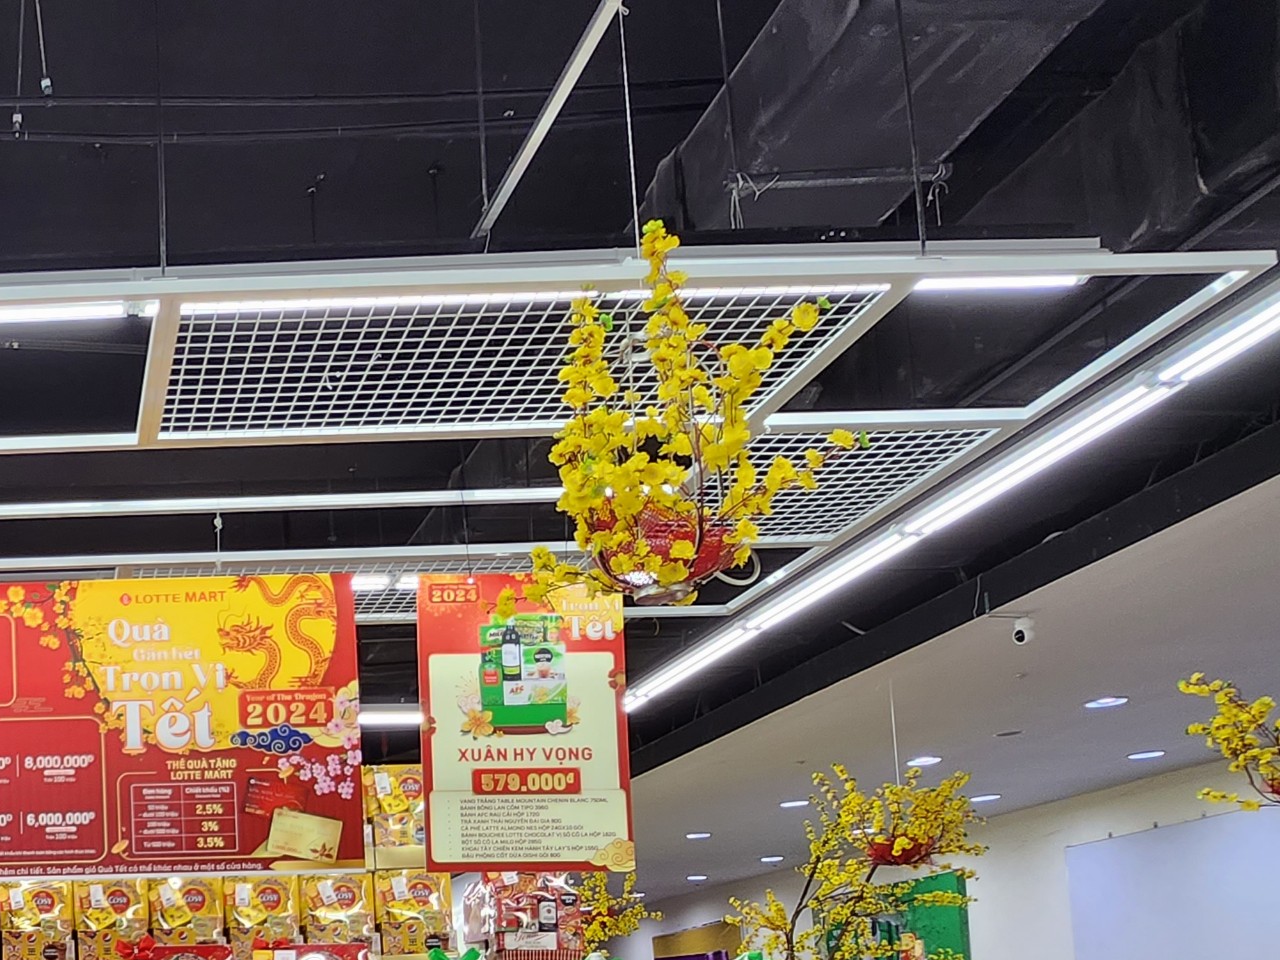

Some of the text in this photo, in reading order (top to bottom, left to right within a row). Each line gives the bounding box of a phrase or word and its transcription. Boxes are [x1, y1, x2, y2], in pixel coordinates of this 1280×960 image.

[135, 591, 225, 604] LOTTE MART
[431, 588, 477, 602] 2024
[108, 617, 170, 647] Quà
[564, 609, 616, 640] Tết
[100, 662, 226, 695] Trọn Vị
[246, 693, 327, 703] Year of The Dragon
[111, 688, 217, 753] Tết
[246, 702, 328, 725] 2024
[166, 757, 236, 770] THẺ QUÀ TẶNG
[458, 745, 593, 765] XUÂN HY VỌNG
[170, 769, 233, 781] LOTTE MART
[201, 821, 219, 832] 3%
